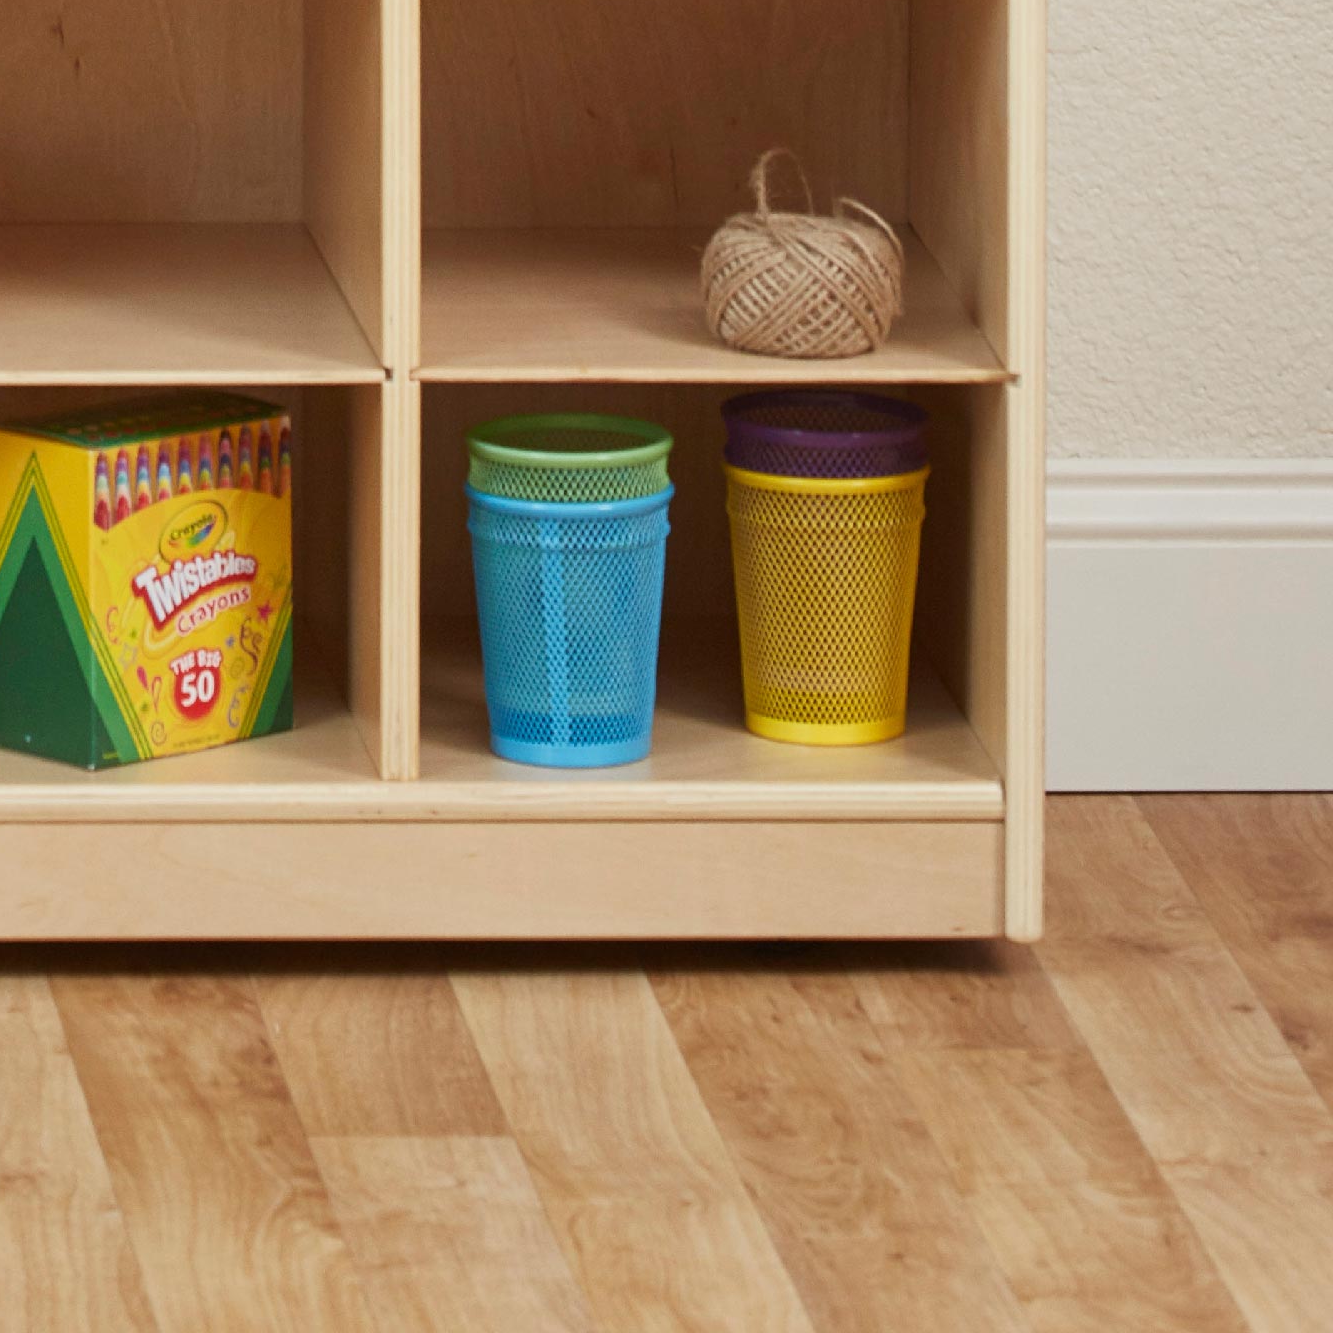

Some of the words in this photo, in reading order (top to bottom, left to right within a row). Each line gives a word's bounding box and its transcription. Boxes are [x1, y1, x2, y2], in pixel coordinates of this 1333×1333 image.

[169, 511, 216, 541] Crayola
[134, 551, 255, 623] Twistables
[177, 586, 250, 634] Crayons
[170, 651, 195, 675] THE
[197, 648, 222, 669] BIG
[180, 669, 215, 708] 50
